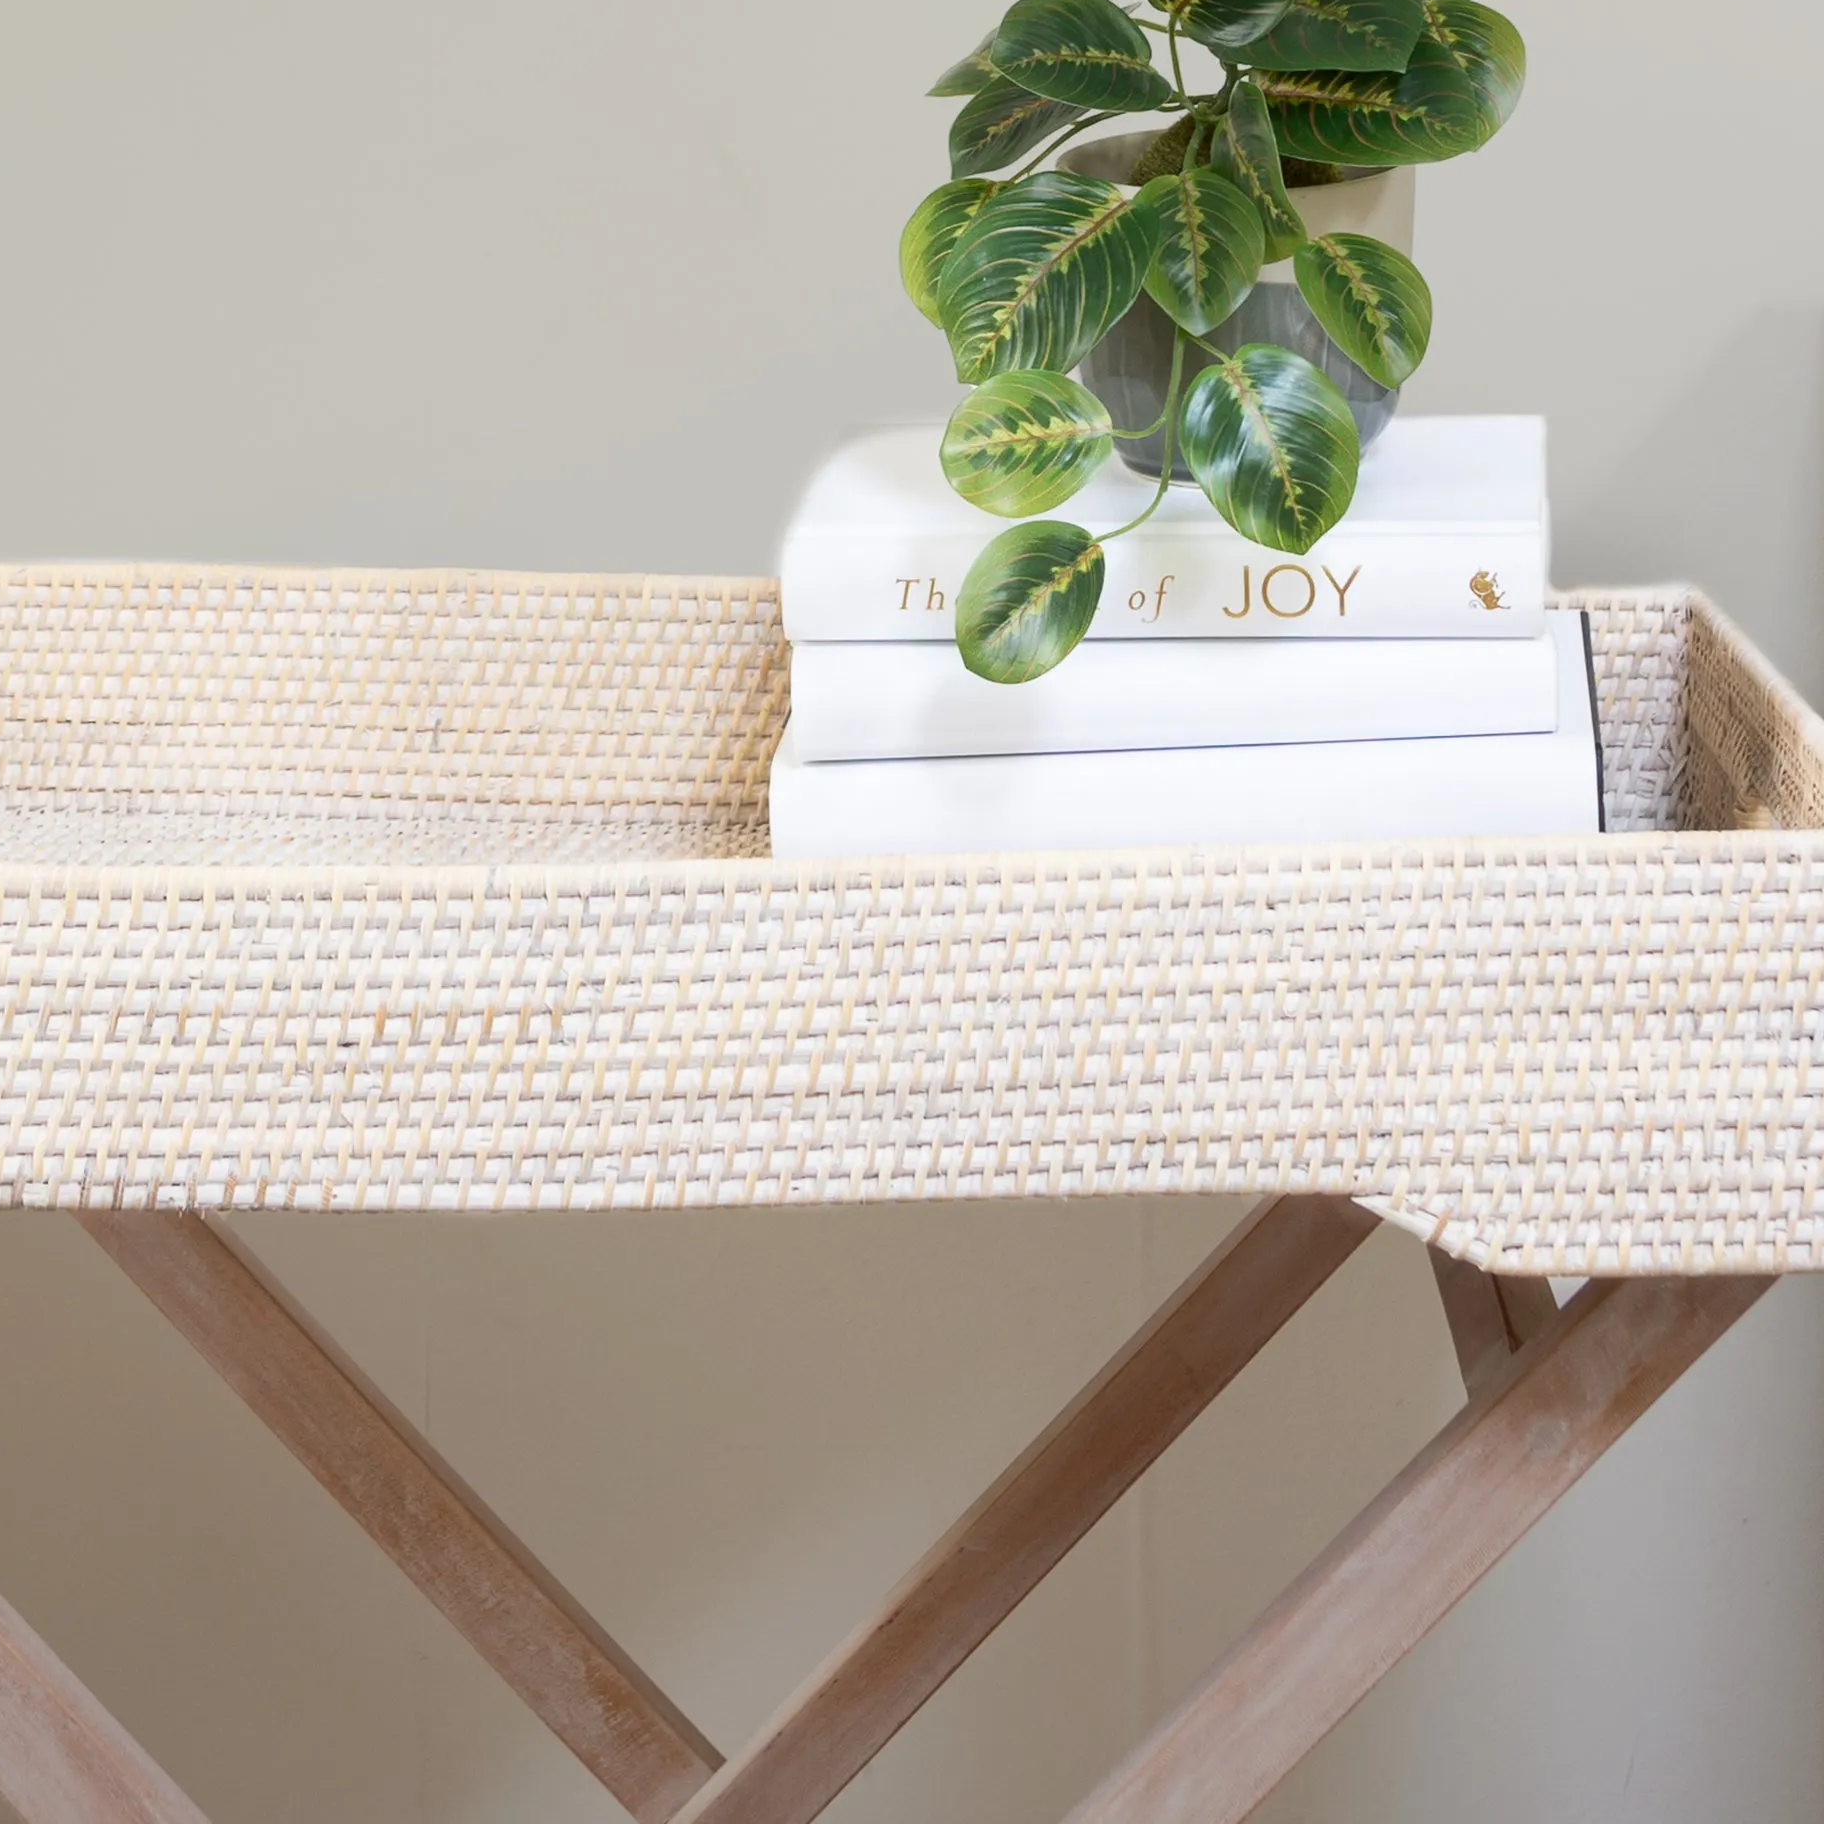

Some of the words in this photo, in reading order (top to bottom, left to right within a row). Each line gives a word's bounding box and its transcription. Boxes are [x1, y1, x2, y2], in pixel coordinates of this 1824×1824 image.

[895, 577, 957, 611] Th
[1127, 575, 1175, 624] of
[1222, 563, 1363, 618] JOY
